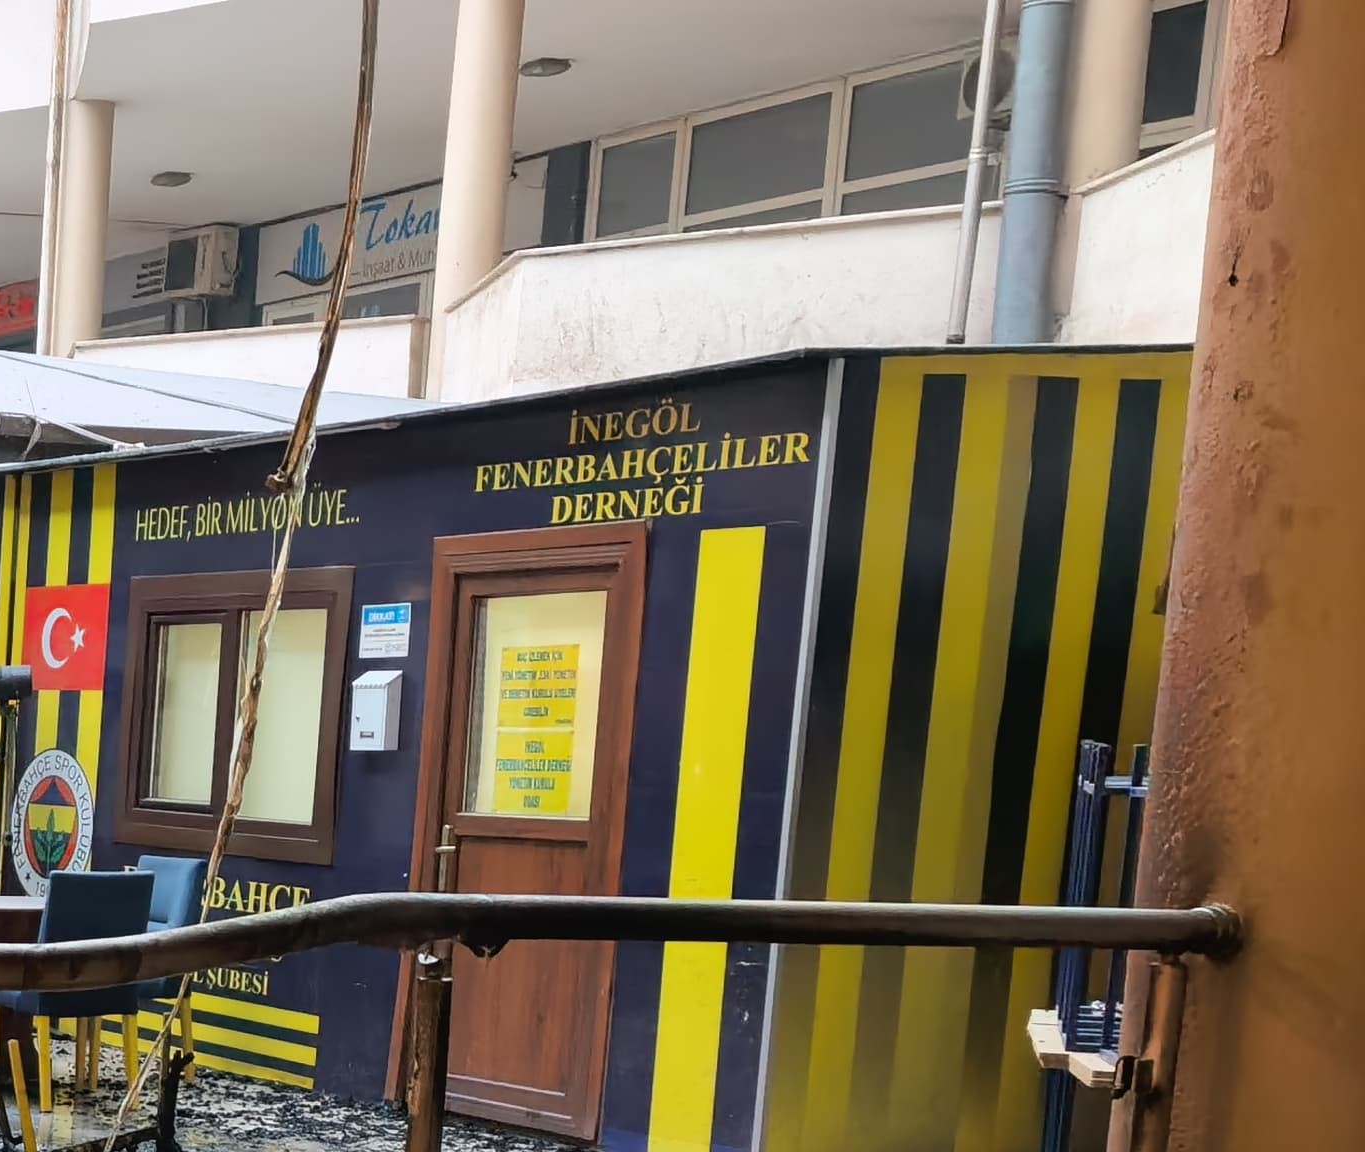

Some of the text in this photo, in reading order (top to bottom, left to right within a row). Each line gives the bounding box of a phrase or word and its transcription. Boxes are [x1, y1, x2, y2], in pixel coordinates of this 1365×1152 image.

[568, 397, 702, 445] İNEGÖL
[473, 431, 812, 493] FENERBAHÇELİLER
[135, 504, 192, 543] HEDEF,
[195, 495, 222, 537] BİR
[225, 490, 303, 534] MİLYON
[550, 476, 705, 524] DERNEĞİ
[54, 754, 83, 789] SPOR
